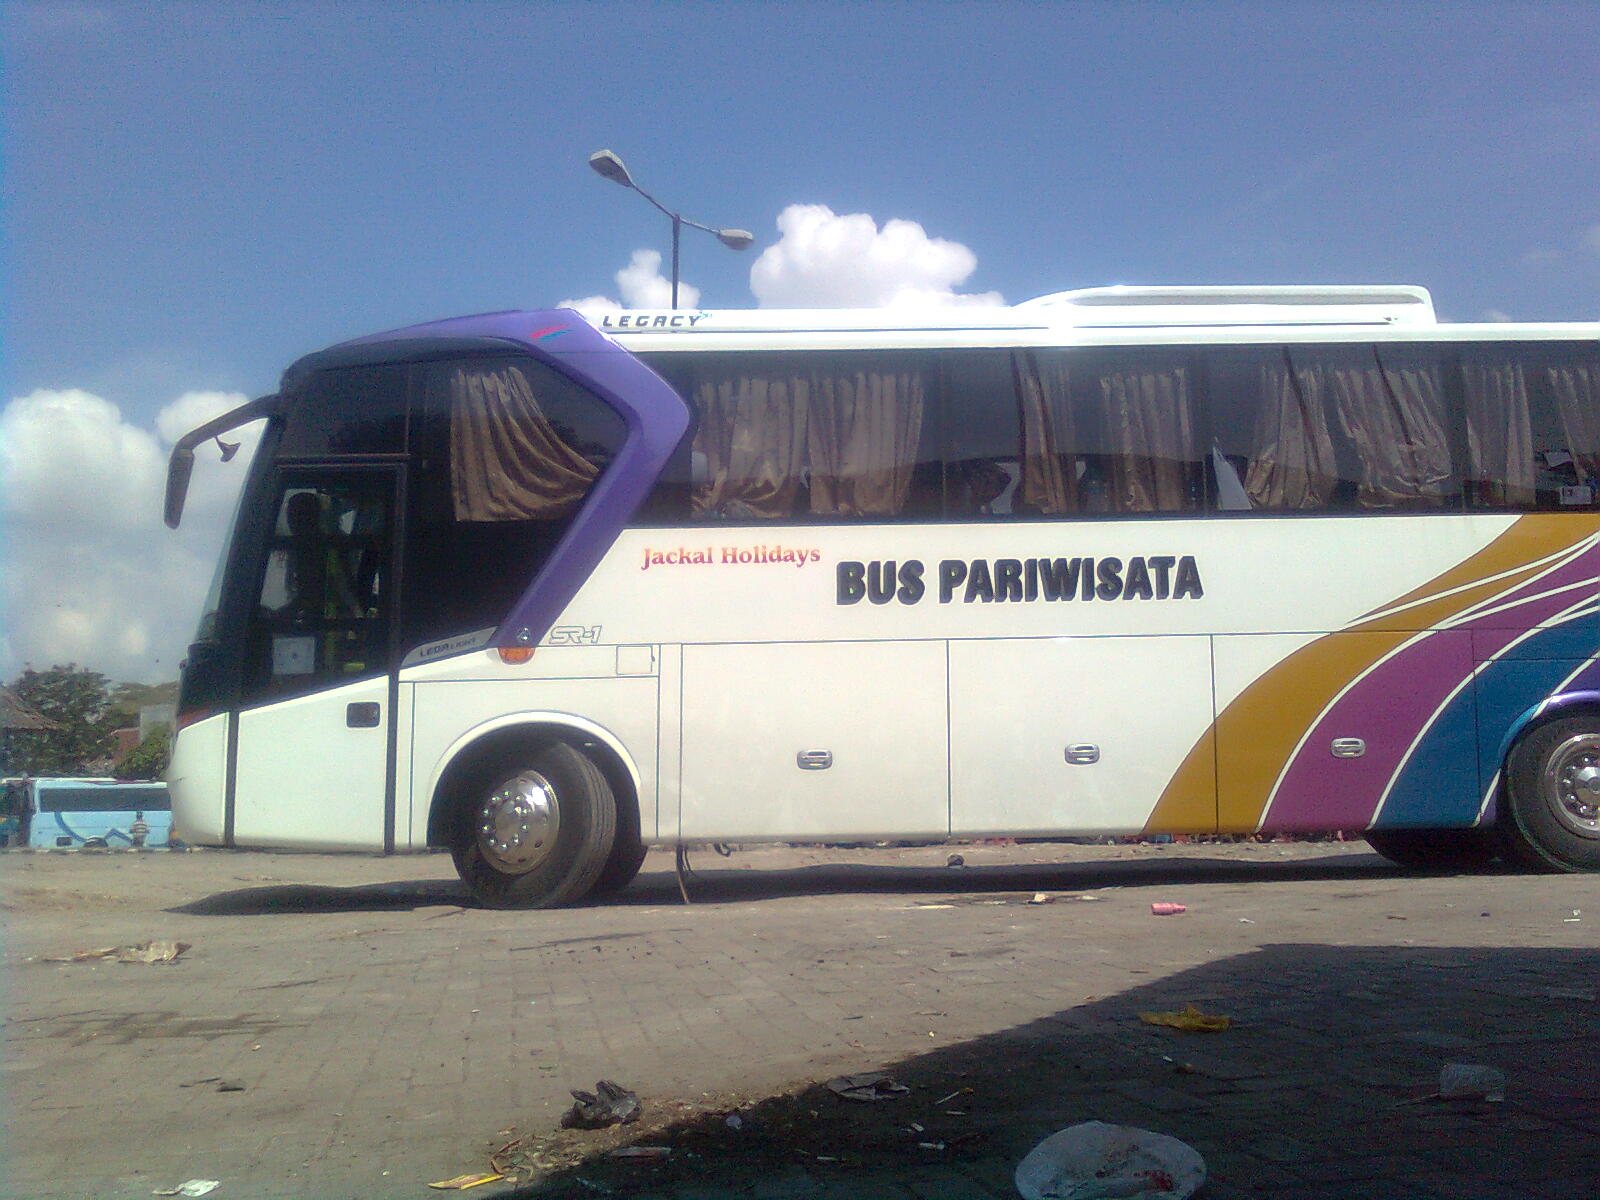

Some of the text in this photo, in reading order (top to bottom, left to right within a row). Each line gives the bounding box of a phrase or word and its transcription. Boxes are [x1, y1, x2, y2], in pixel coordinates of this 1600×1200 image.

[602, 315, 701, 328] LEGACY
[641, 545, 821, 571] Jackal Holidays
[836, 555, 1204, 606] BUS PARIWISATA
[549, 625, 603, 644] SR-1
